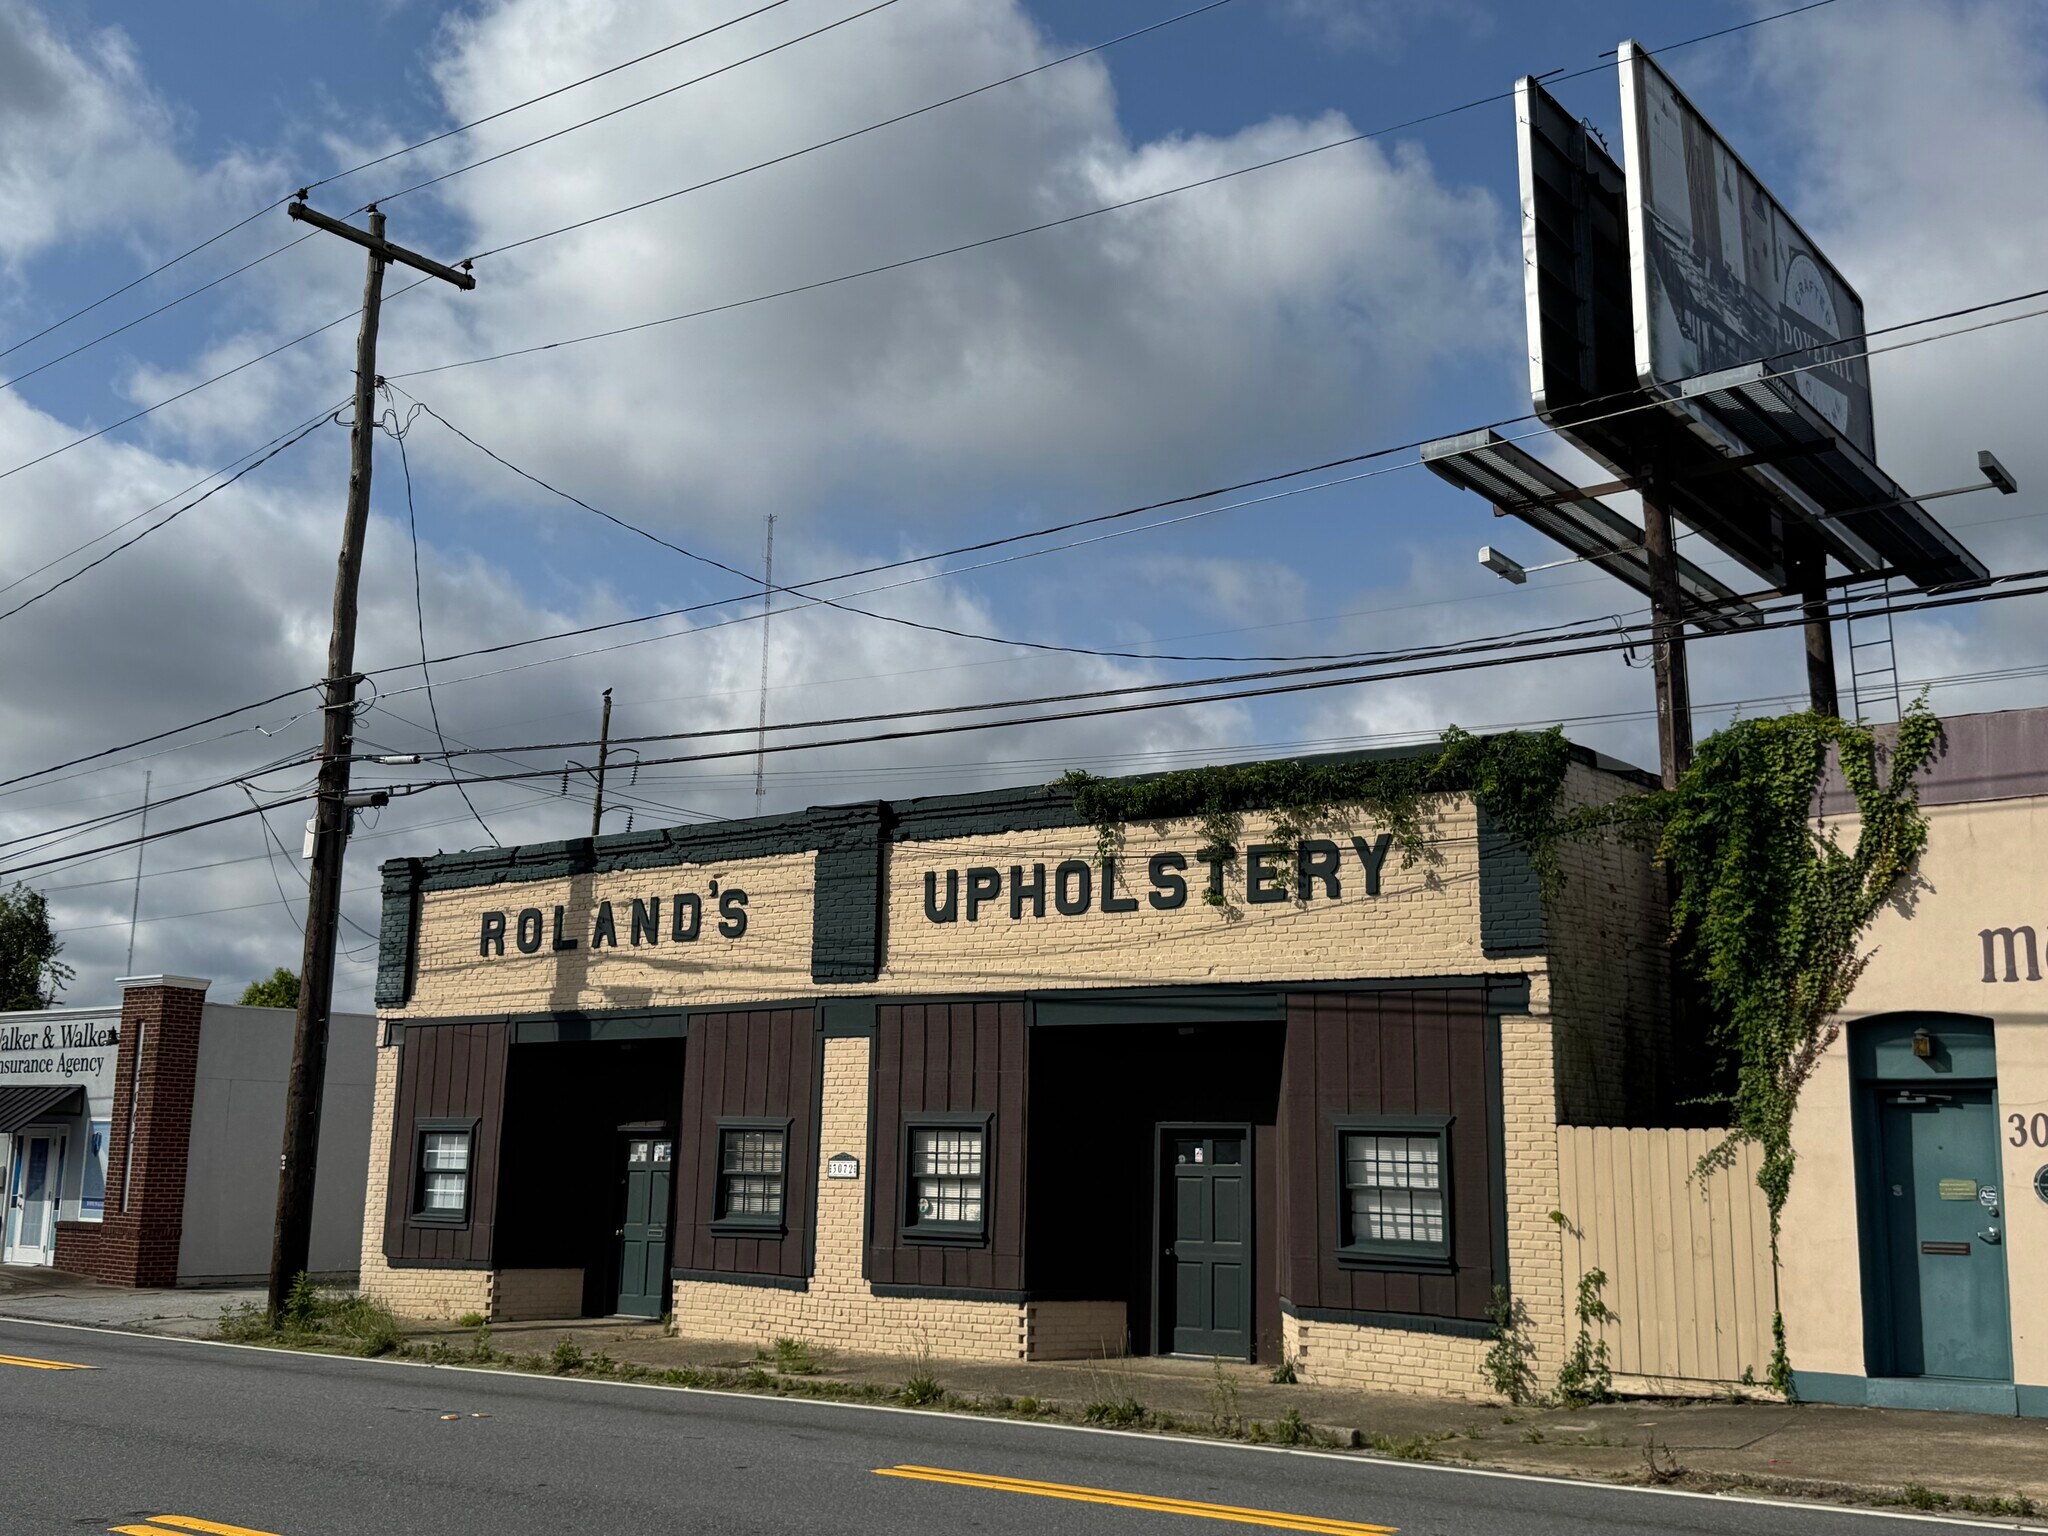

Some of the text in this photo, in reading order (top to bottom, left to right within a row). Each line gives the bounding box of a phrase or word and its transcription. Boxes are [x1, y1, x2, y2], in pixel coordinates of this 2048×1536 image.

[1782, 318, 1852, 383] DOVETAIL
[924, 833, 1393, 923] UPHOLSTERY
[479, 879, 748, 957] ROLAND'S
[1977, 925, 2048, 983] m
[0, 1026, 38, 1051] alker
[42, 1025, 55, 1049] &
[56, 1052, 104, 1078] Agency
